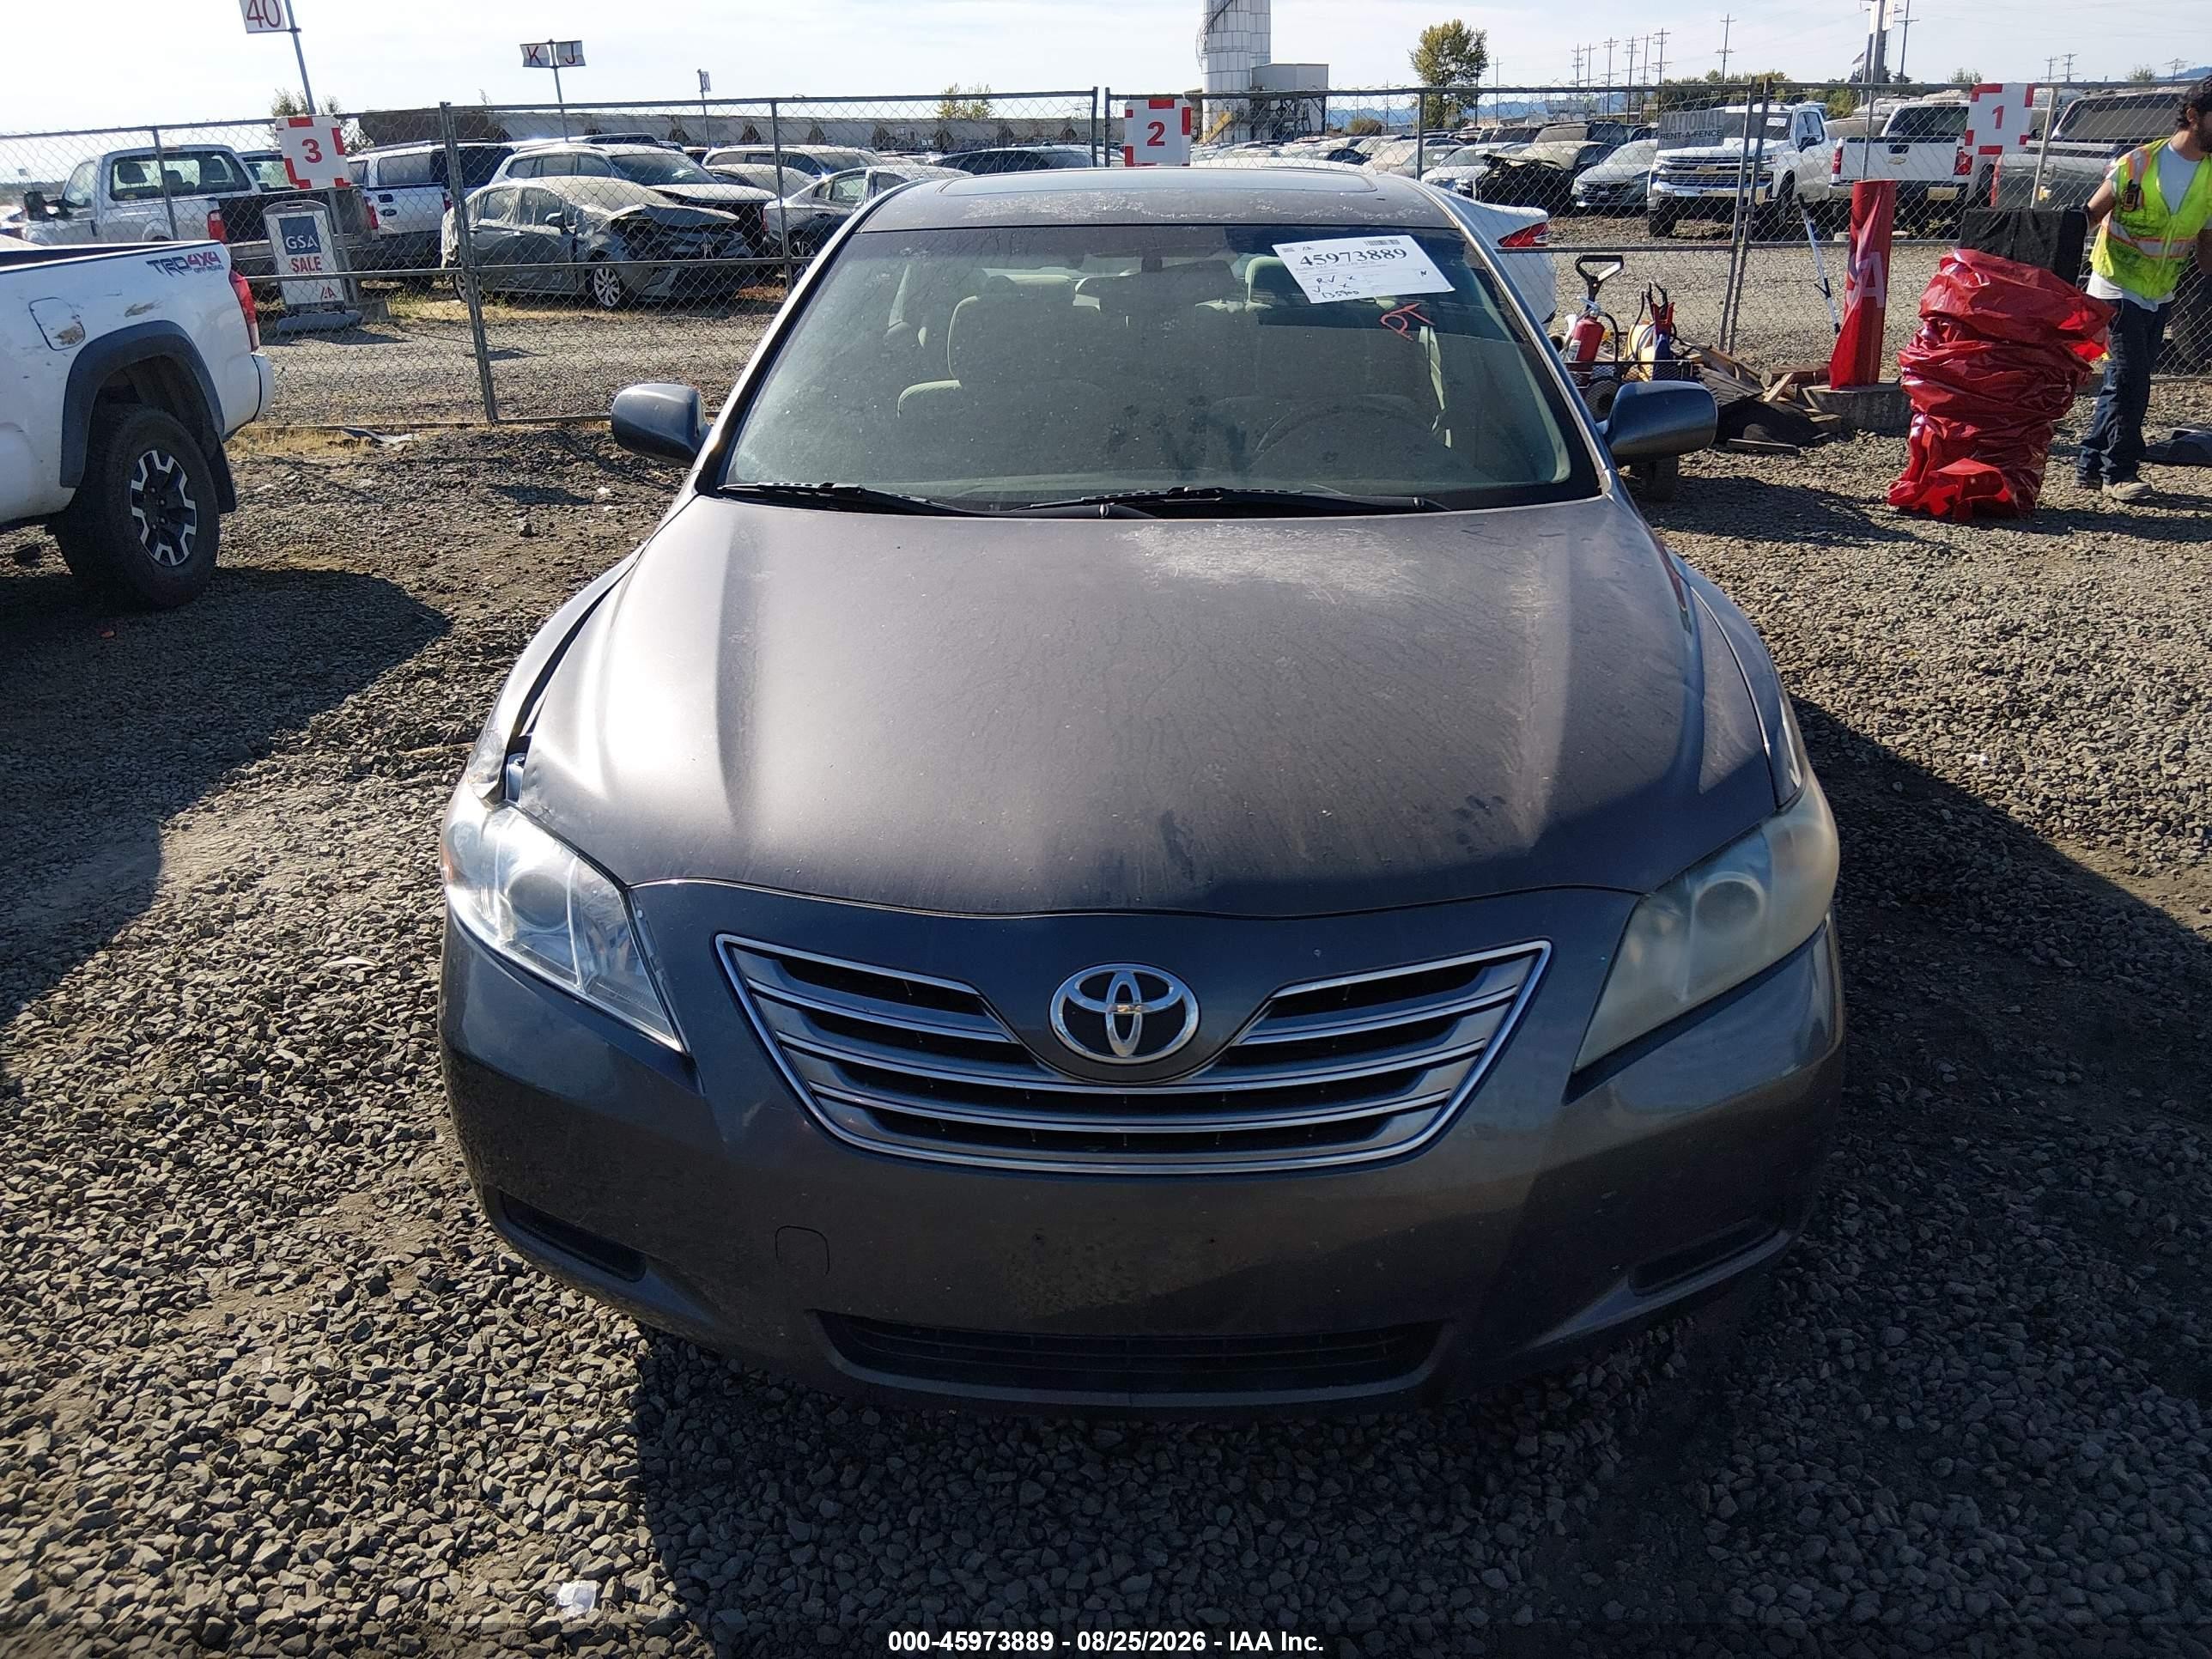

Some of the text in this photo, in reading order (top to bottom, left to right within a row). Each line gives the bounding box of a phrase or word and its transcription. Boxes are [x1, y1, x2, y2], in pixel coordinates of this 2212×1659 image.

[246, 0, 281, 27] 40
[526, 46, 543, 65] K
[565, 43, 575, 64] J
[1660, 112, 1723, 131] NATIONAL
[1992, 106, 2004, 130] 1
[1146, 121, 1165, 147] 2
[1660, 129, 1723, 140] RENT-A-FENCE
[301, 138, 322, 163] 3
[285, 234, 319, 250] GSA
[145, 256, 191, 277] TRD
[290, 256, 322, 273] SALE
[1300, 248, 1407, 265] 45973889
